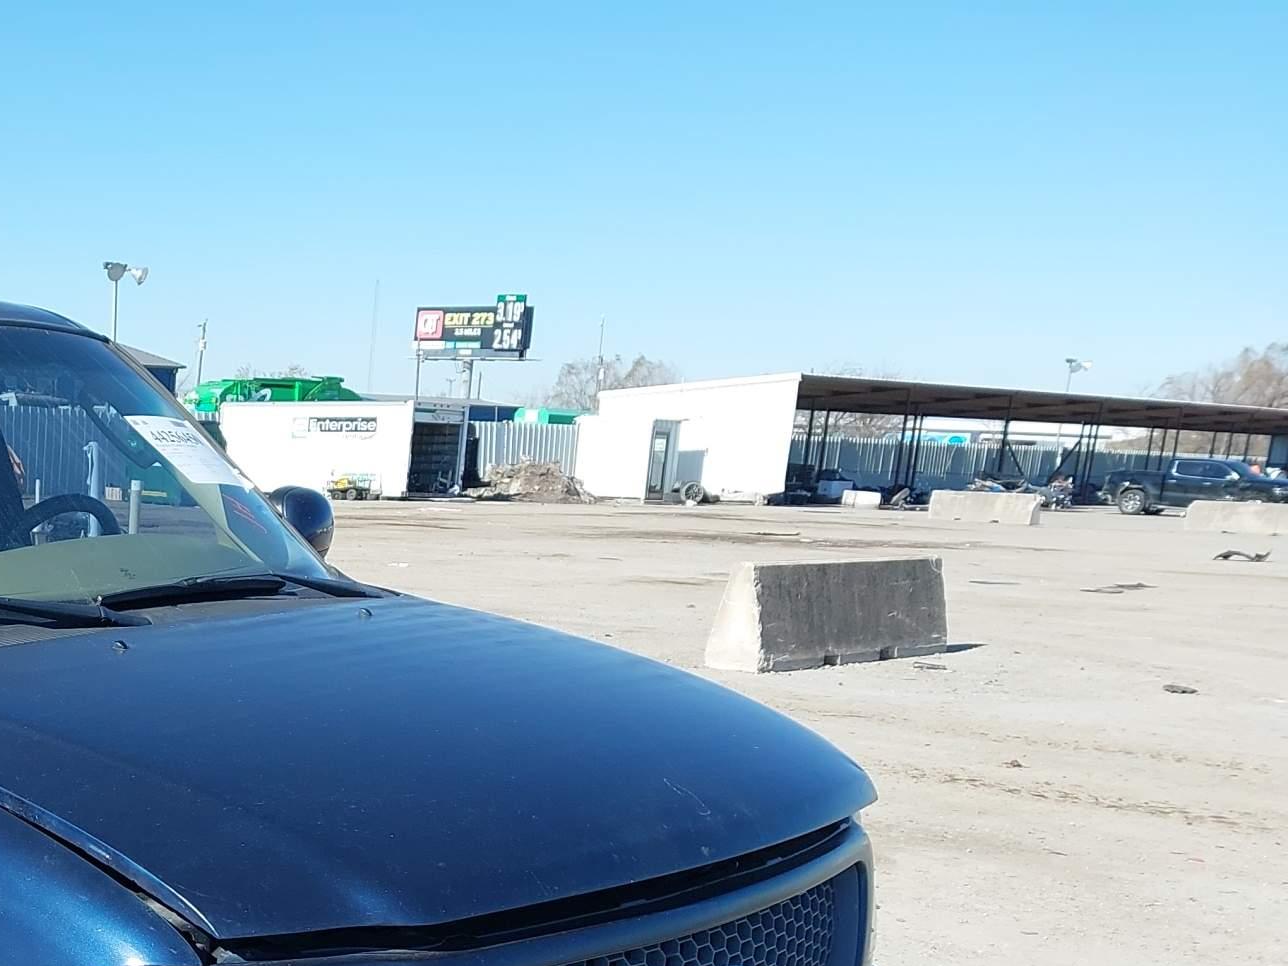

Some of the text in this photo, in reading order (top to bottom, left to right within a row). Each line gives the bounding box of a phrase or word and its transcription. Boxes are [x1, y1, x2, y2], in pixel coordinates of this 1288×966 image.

[444, 312, 471, 325] EXIT
[471, 312, 495, 325] 273
[309, 417, 377, 432] Enterprise
